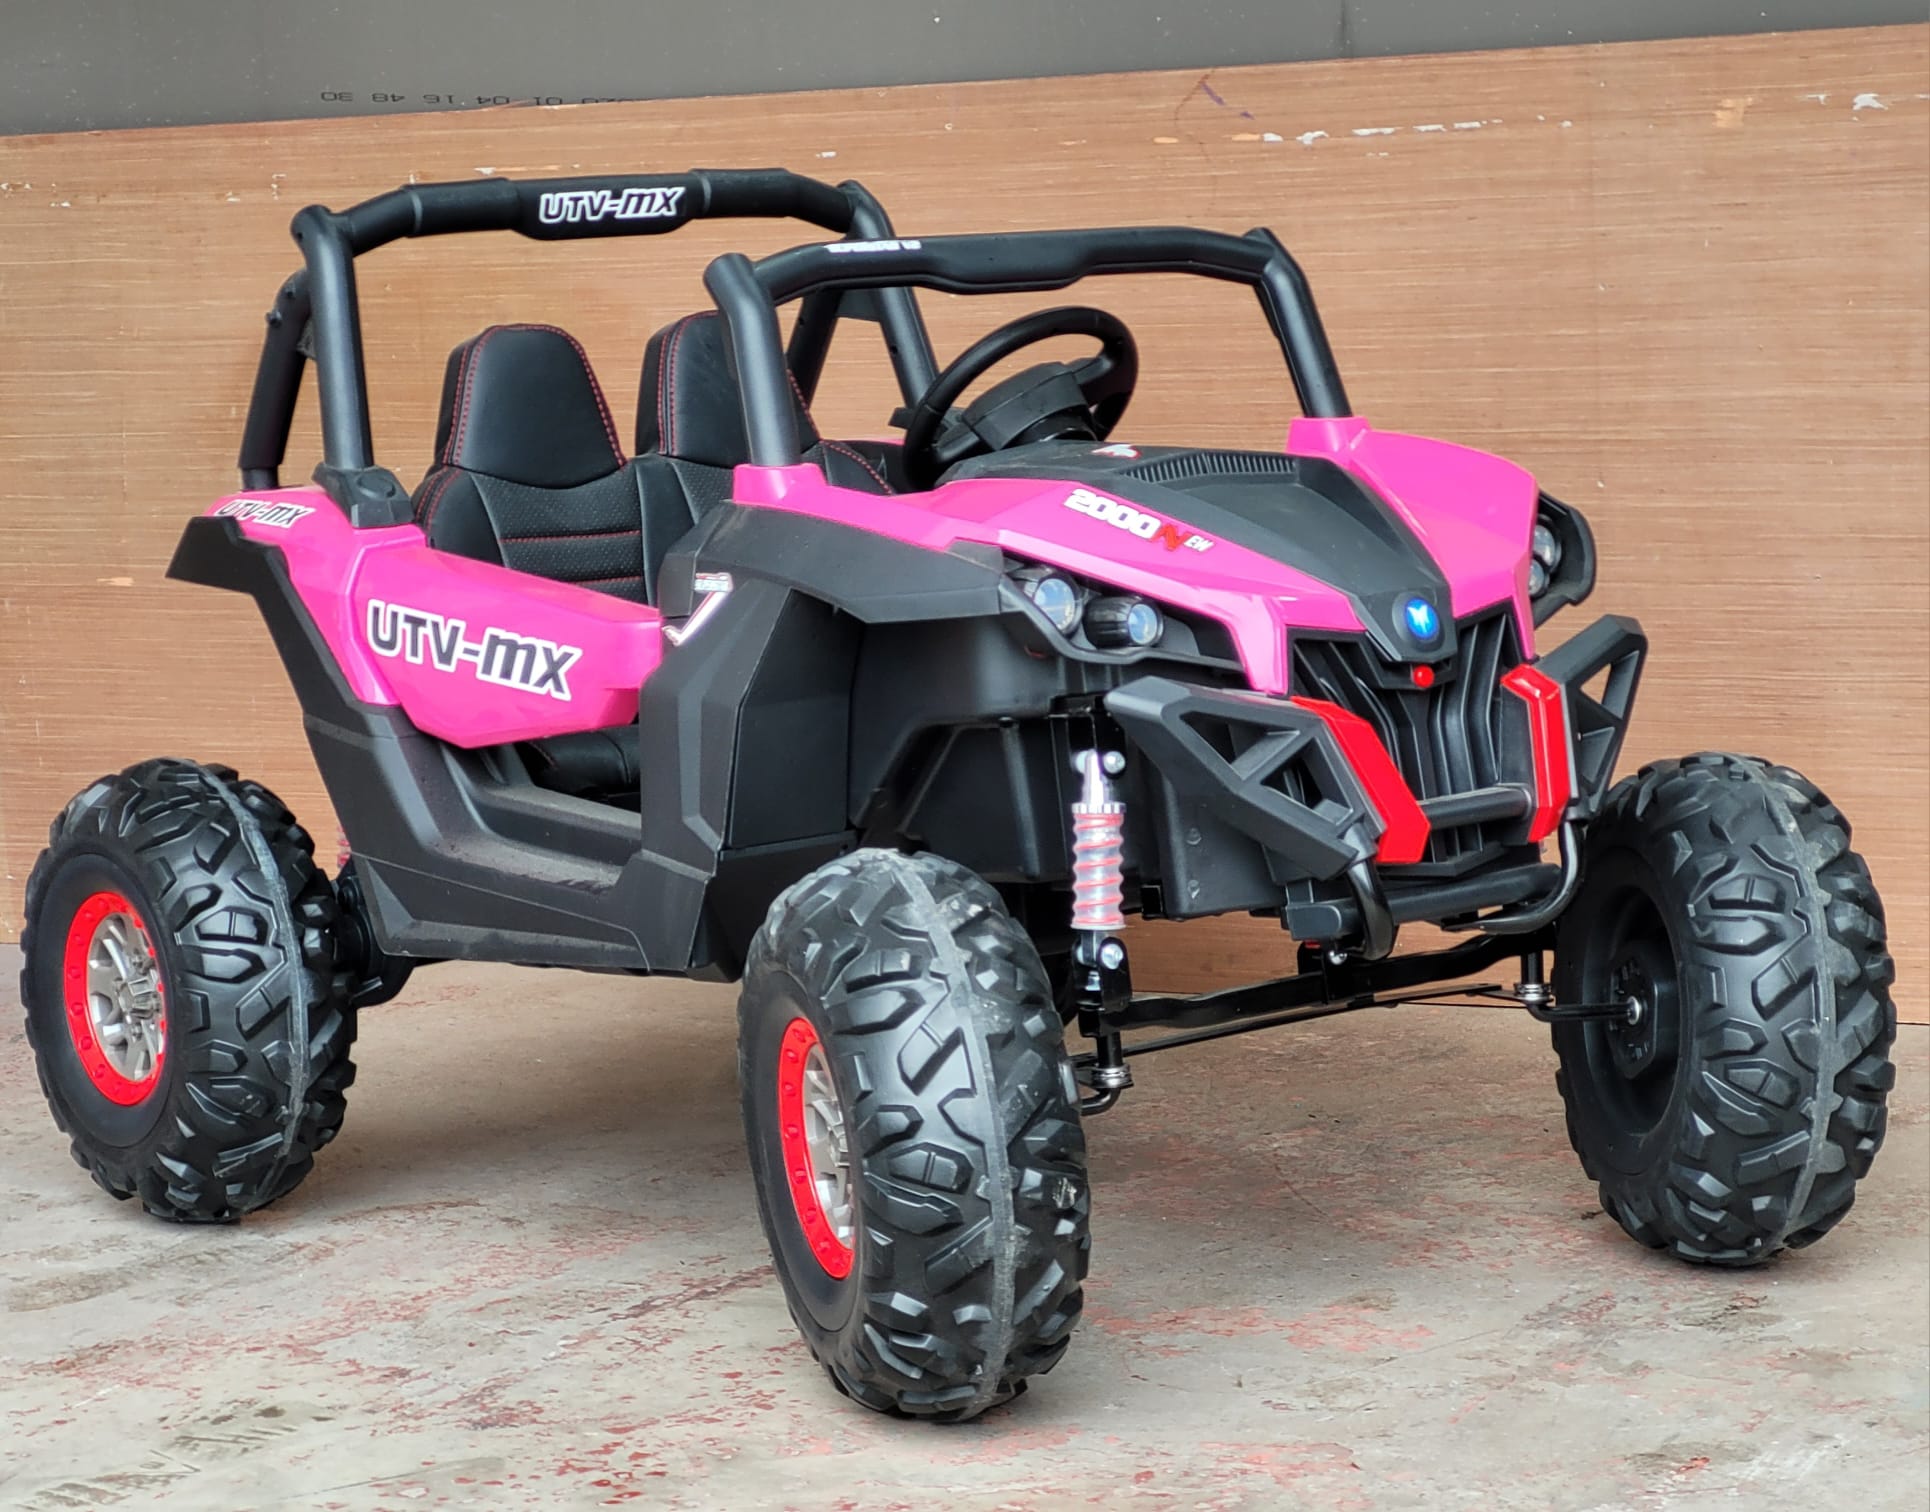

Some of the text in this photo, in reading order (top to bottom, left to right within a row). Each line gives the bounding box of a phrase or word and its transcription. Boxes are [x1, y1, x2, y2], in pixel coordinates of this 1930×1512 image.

[321, 92, 352, 102] 30
[372, 93, 405, 103] 48
[423, 94, 454, 104] 16
